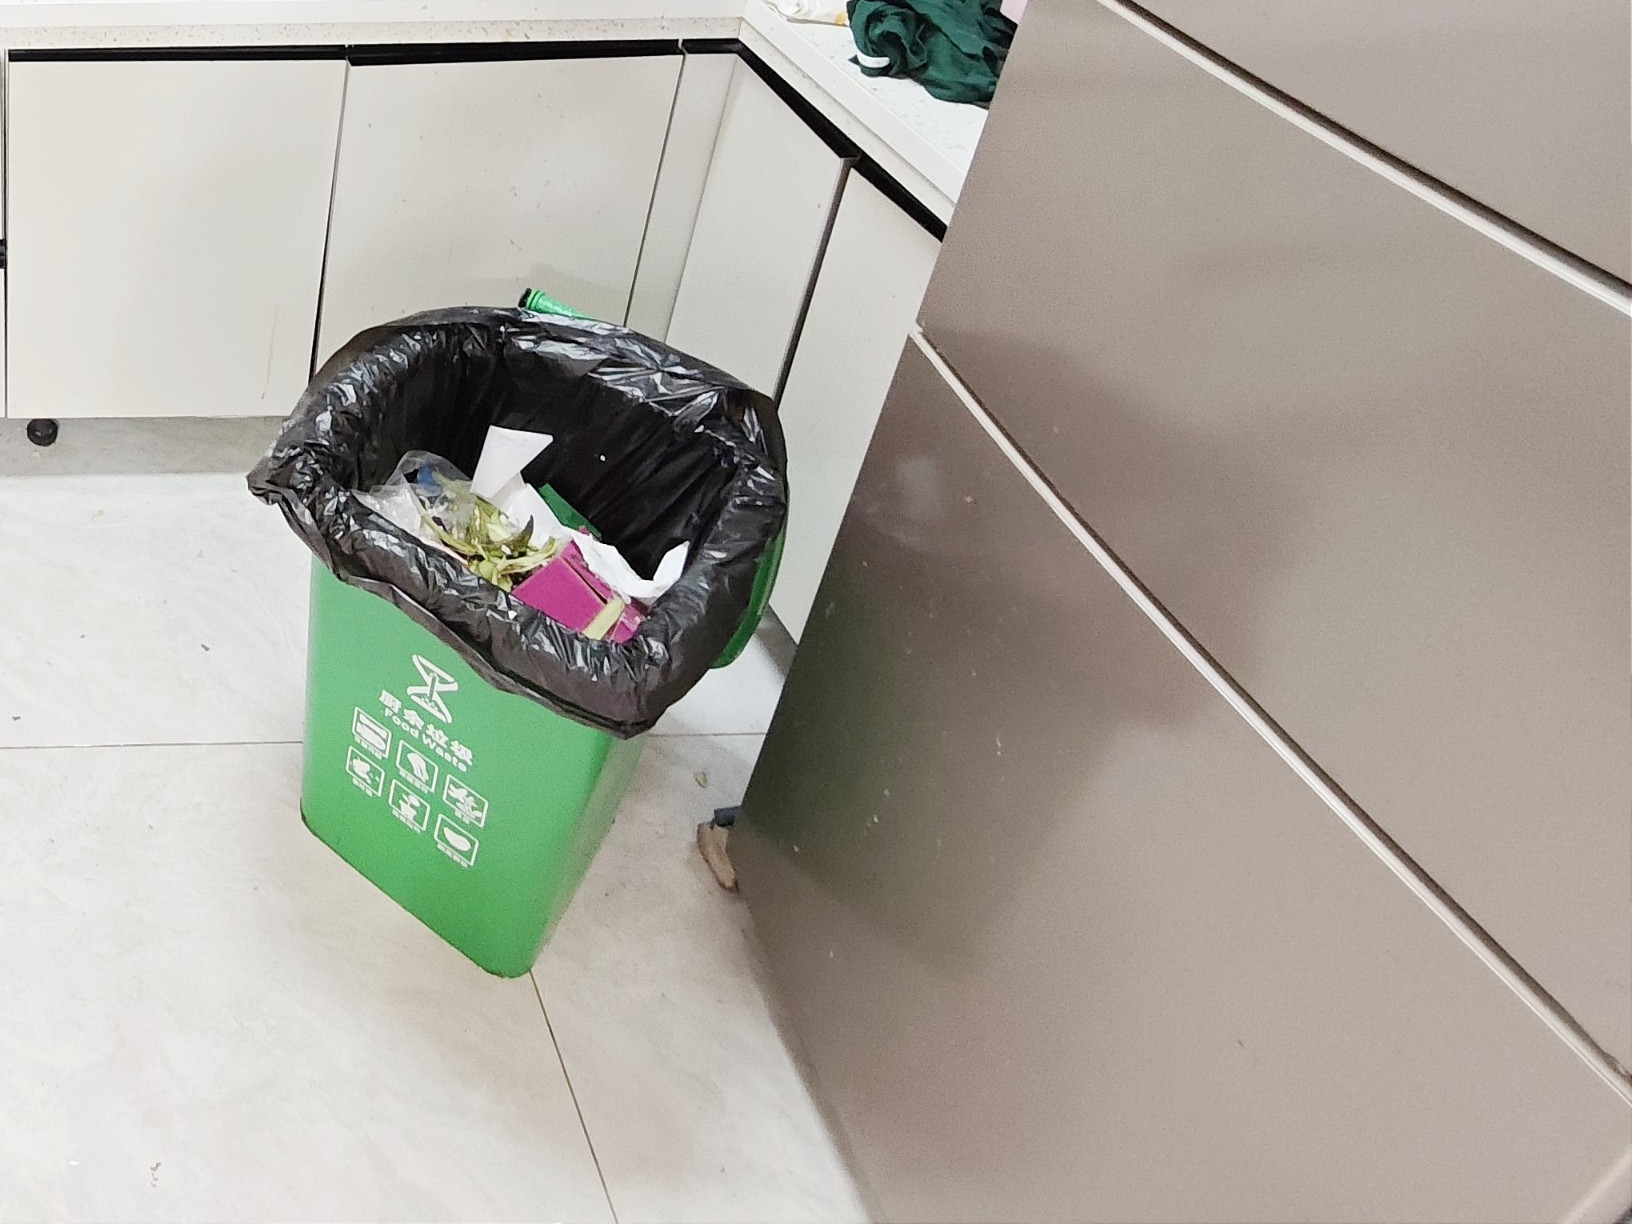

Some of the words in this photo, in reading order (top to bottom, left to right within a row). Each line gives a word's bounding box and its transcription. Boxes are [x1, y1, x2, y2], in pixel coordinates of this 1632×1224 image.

[378, 689, 474, 766] 厨余垃圾
[383, 706, 421, 739] Food
[421, 733, 468, 773] Waste
